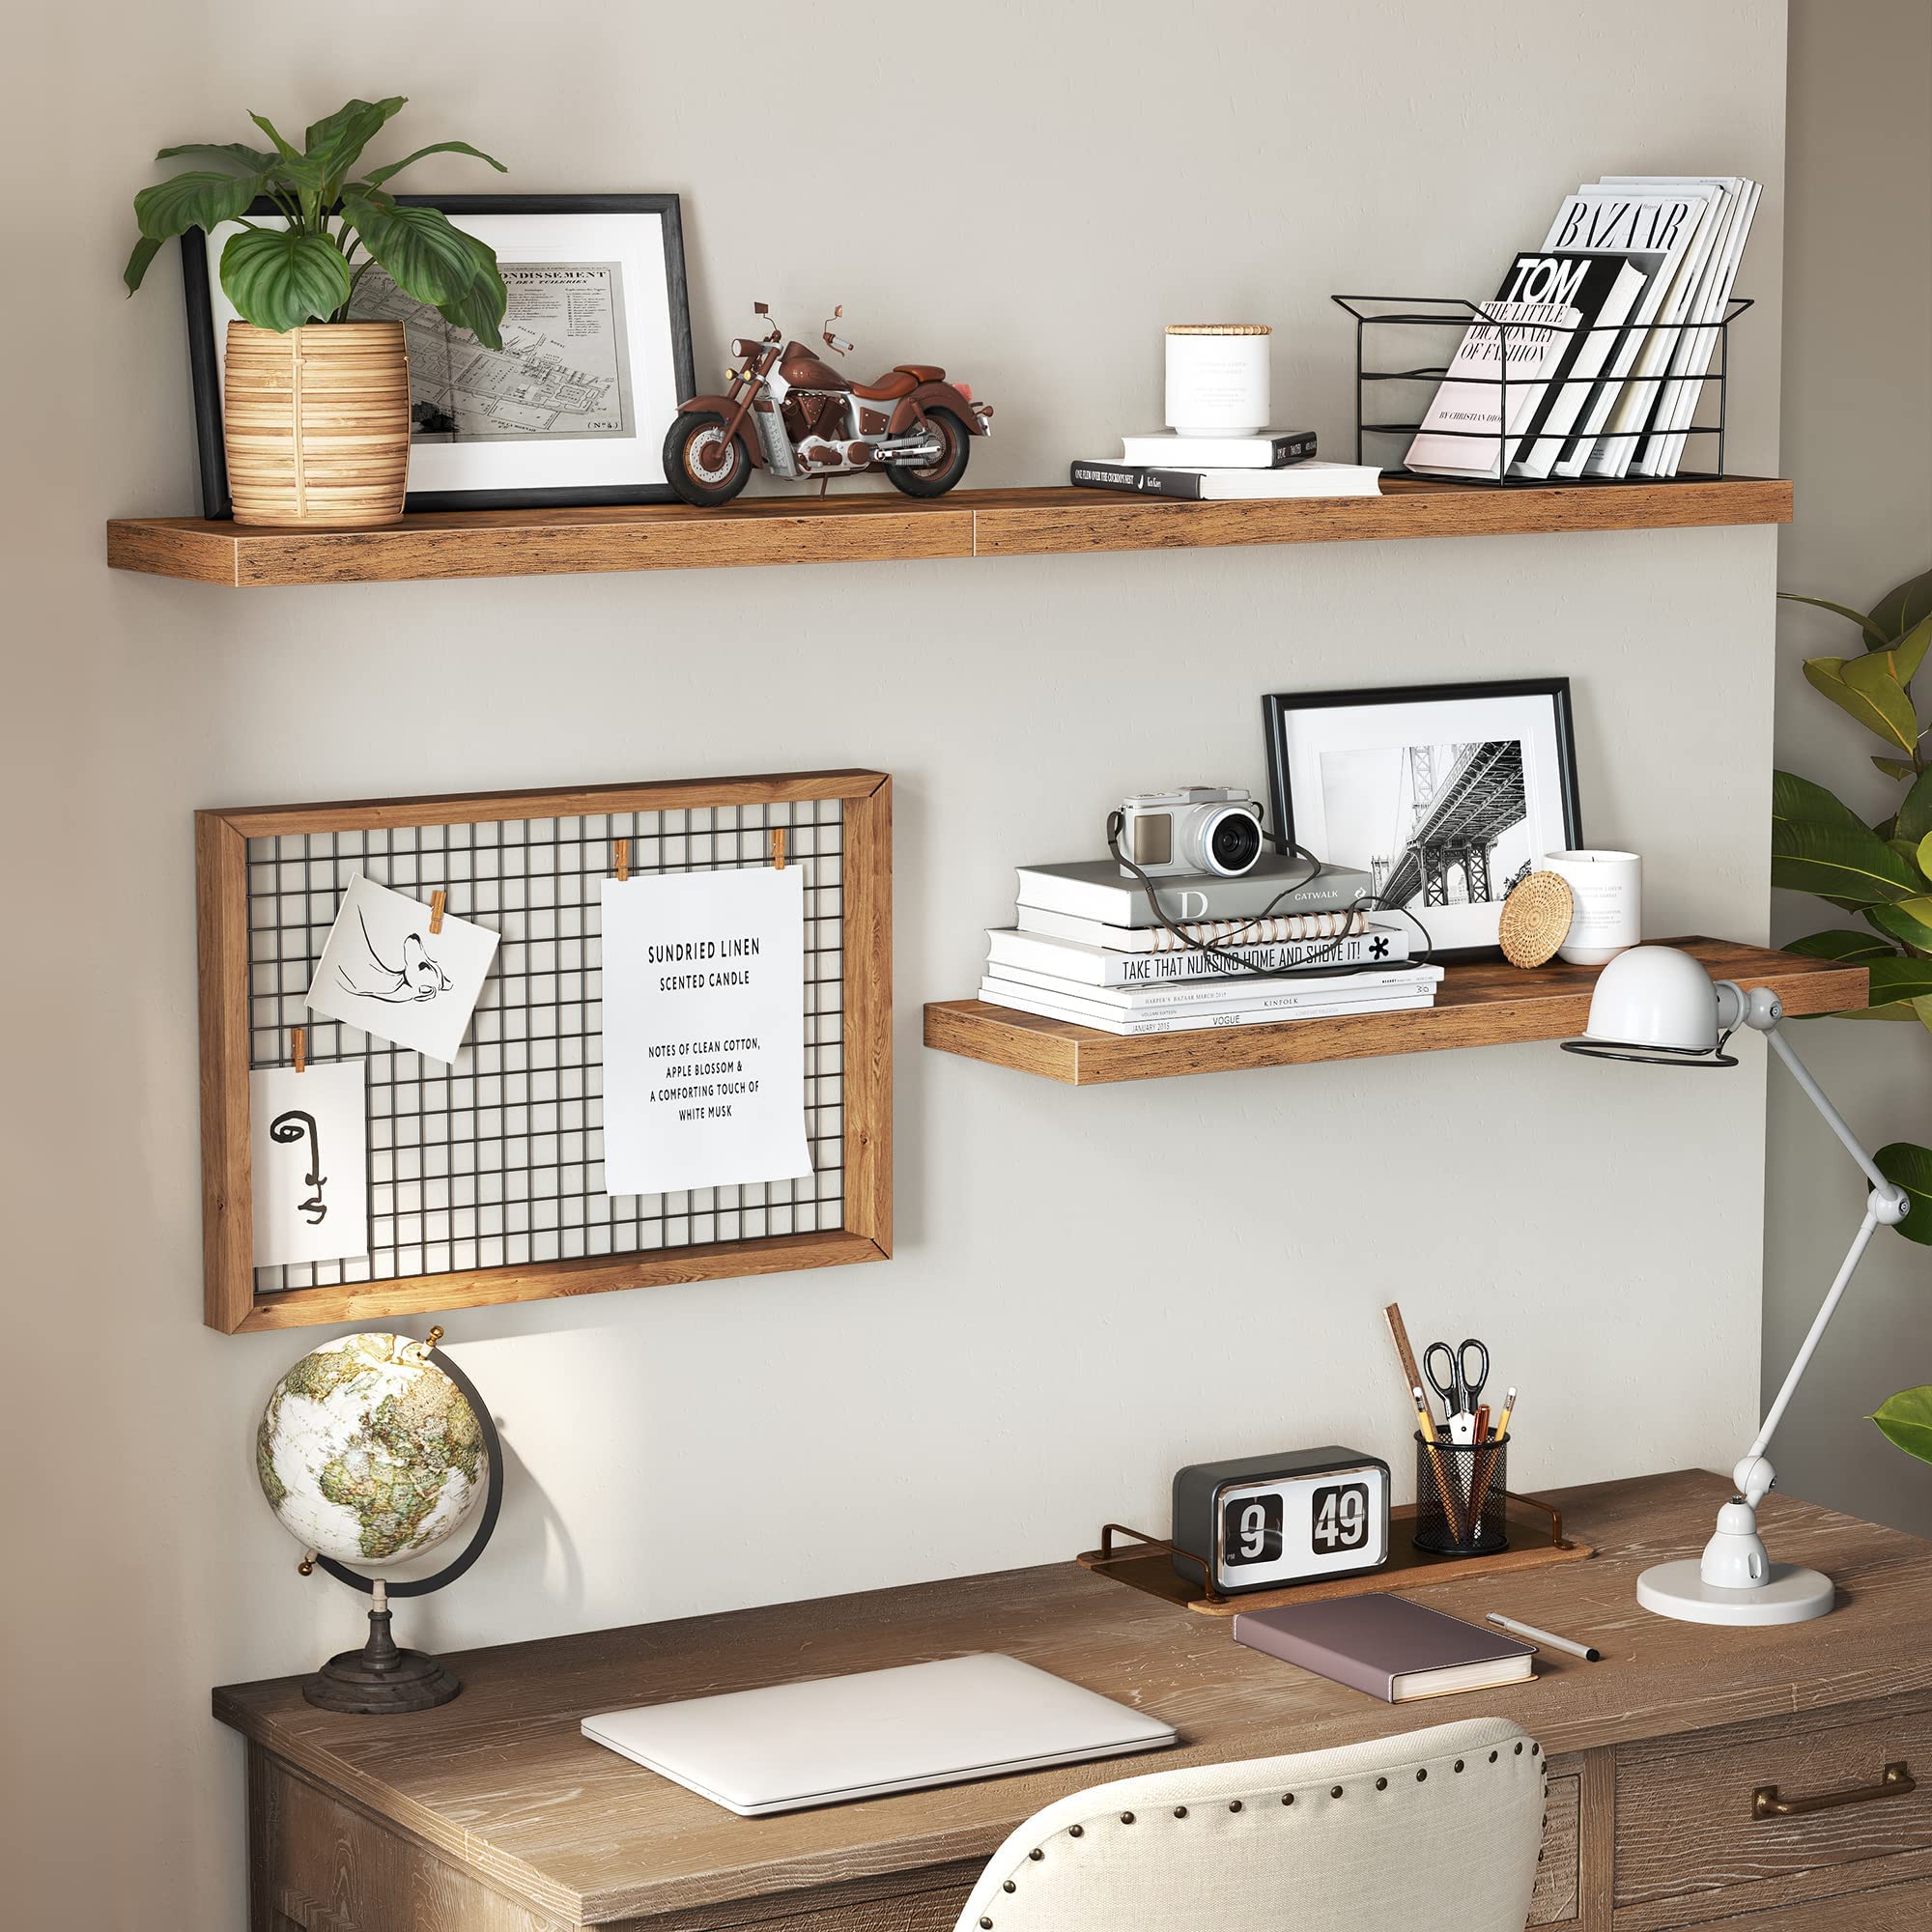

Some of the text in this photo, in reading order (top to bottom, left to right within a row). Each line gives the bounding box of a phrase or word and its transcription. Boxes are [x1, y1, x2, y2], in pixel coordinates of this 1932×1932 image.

[1555, 202, 1689, 250] BAZAAR
[1507, 257, 1592, 303] TOM
[1481, 302, 1568, 323] THE LITTLE
[1461, 342, 1485, 360] OF
[1449, 412, 1486, 421] CHRISTIAN
[1177, 891, 1208, 920] D
[1294, 890, 1339, 901] CATWALK
[648, 937, 759, 964] SUNDRIED LINEN
[1122, 941, 1360, 980] TAKE THAT NURSING HOME AND SHOVE IT!
[660, 970, 750, 991] SCENTED CANDLE
[1264, 997, 1298, 1008] KINFOLK
[1132, 1023, 1156, 1034] JANUARY
[1212, 1014, 1241, 1026] VOGUE
[648, 1037, 760, 1058] NOTES OF CLEAN COTTON,
[666, 1060, 743, 1078] APPLE BLOSSOM &
[650, 1080, 759, 1102] A COMFORTING TOUCH OF
[678, 1104, 732, 1121] WHITE MUSK
[1239, 1489, 1365, 1559] 9 49
